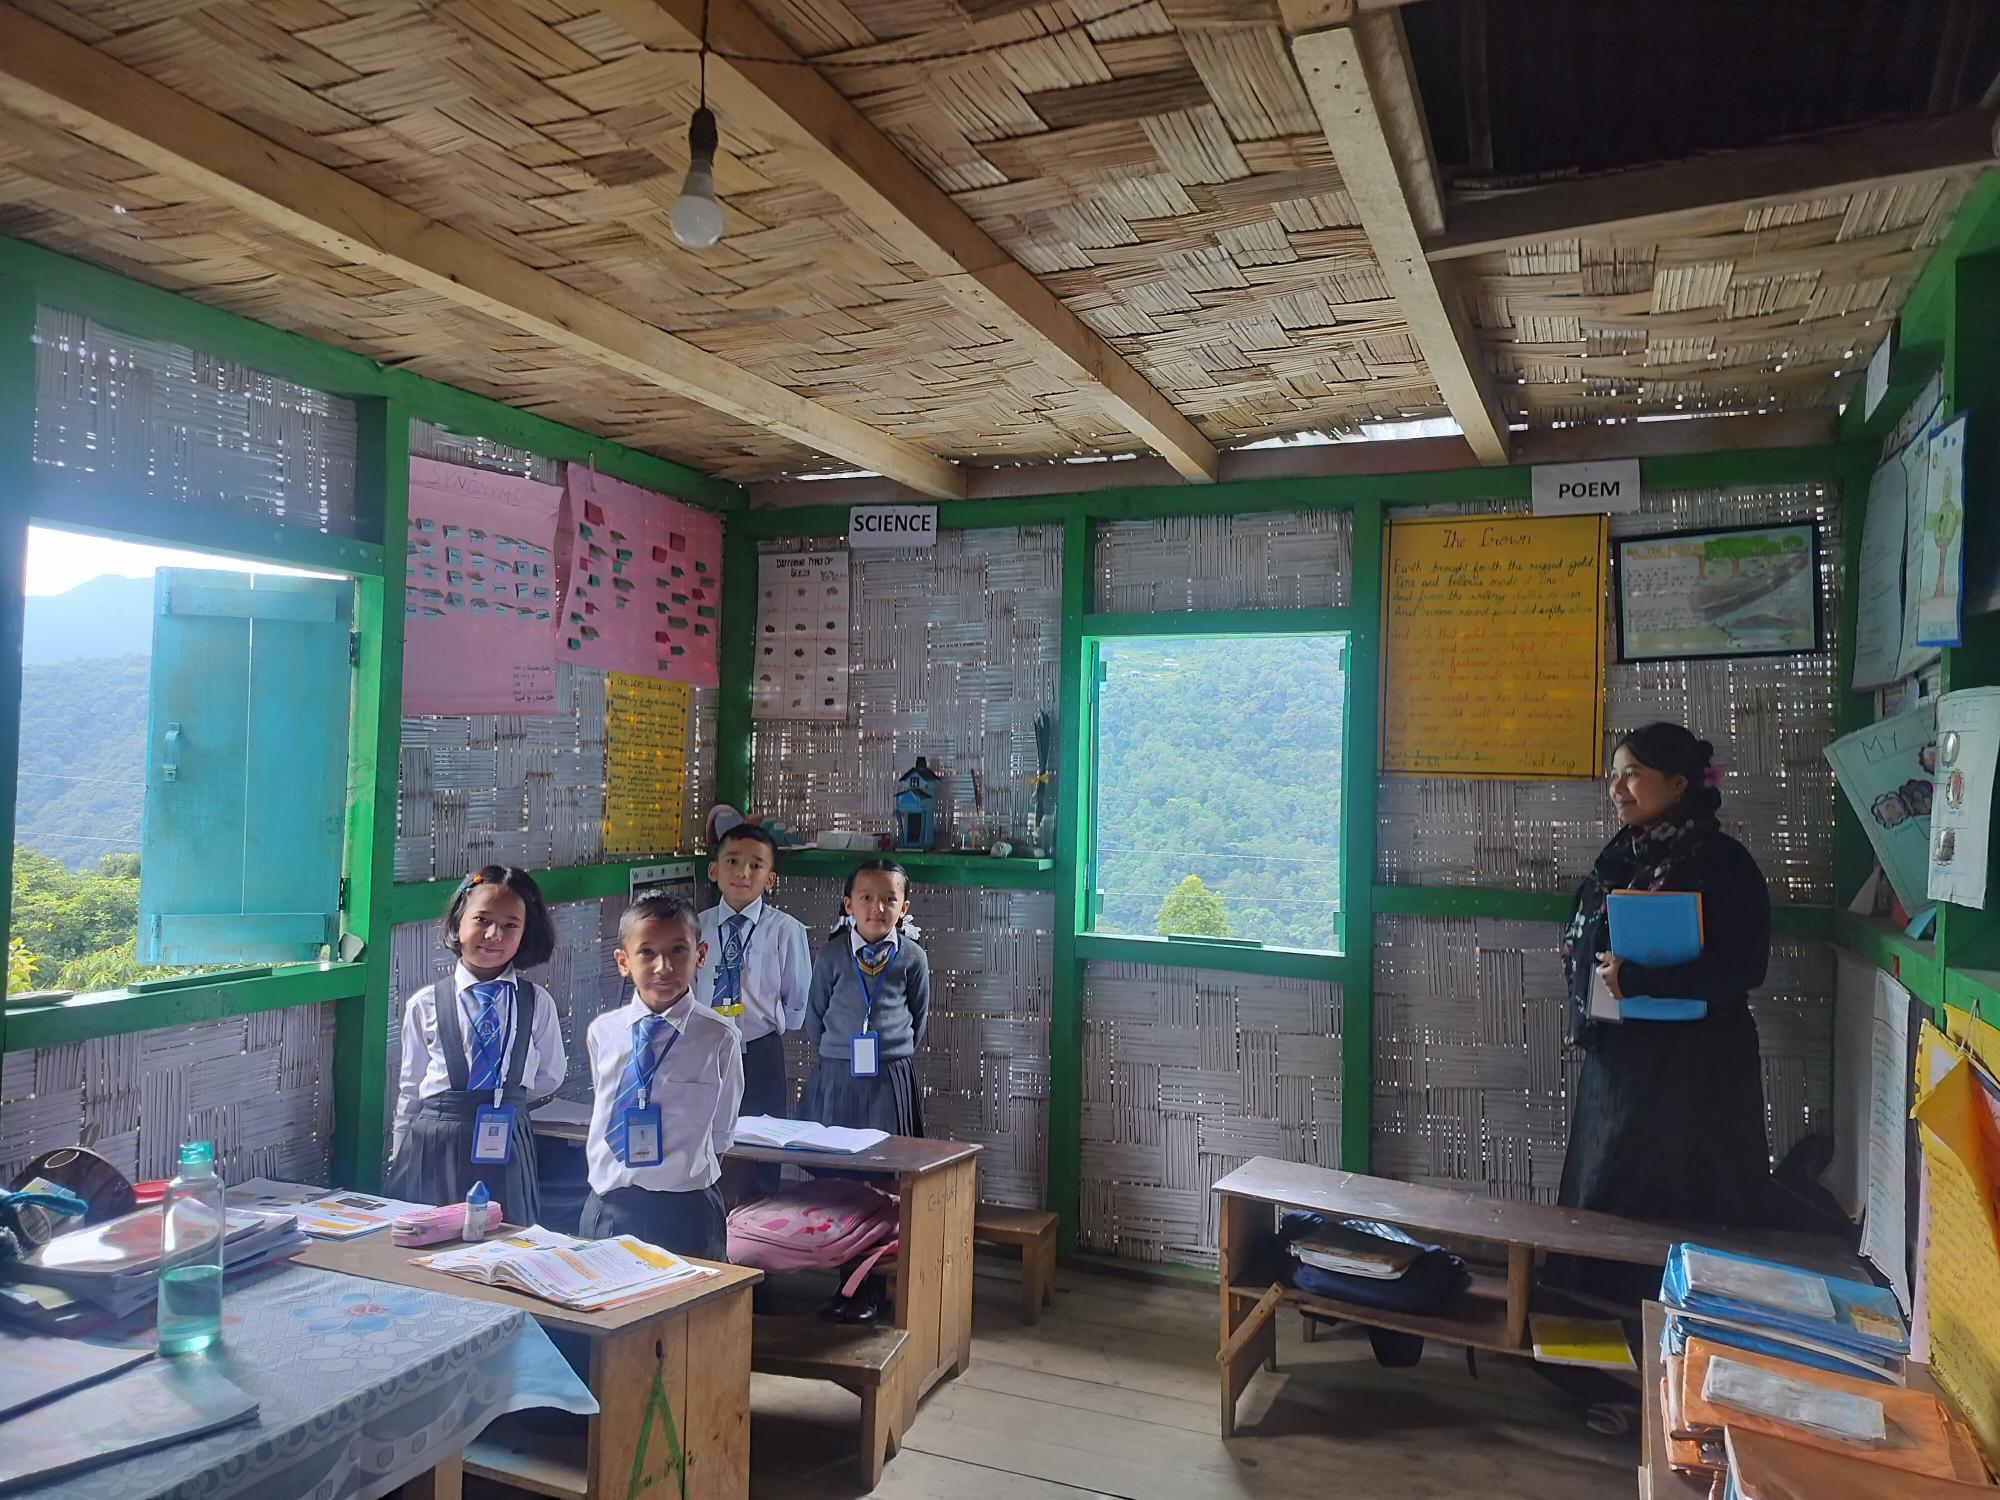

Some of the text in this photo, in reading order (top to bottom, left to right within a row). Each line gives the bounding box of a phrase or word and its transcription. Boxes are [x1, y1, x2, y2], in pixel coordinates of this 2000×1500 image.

[428, 464, 521, 508] SYNONYMS
[1558, 480, 1620, 498] POEM
[854, 514, 931, 532] SCIENCE
[1442, 527, 1531, 548] The Crown
[1394, 559, 1422, 574] Earth
[1508, 559, 1522, 571] the
[1421, 575, 1440, 587] and
[1861, 730, 1897, 764] MY
[627, 1360, 691, 1500] A
